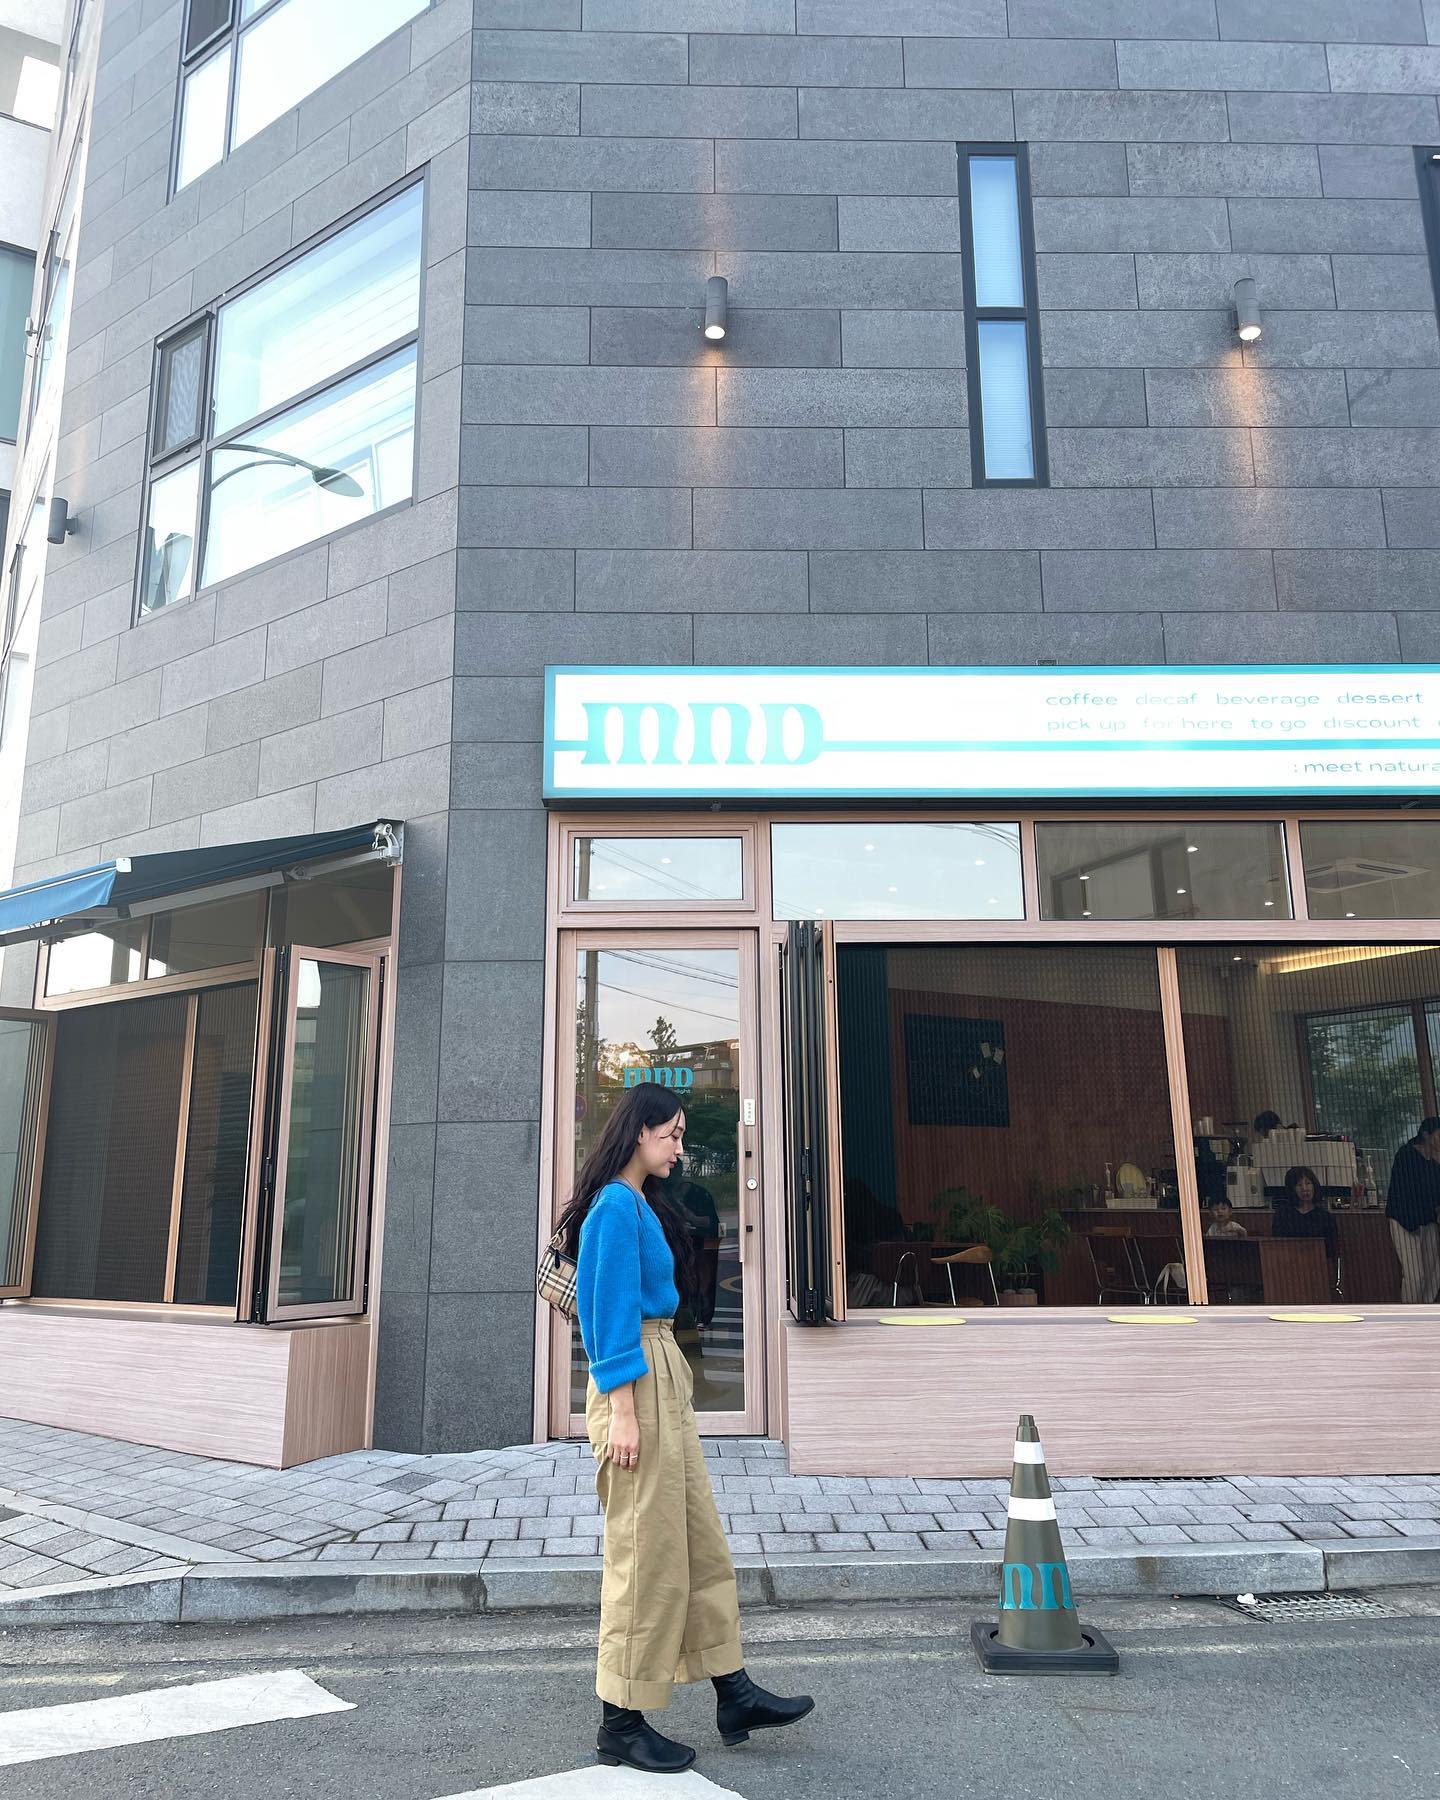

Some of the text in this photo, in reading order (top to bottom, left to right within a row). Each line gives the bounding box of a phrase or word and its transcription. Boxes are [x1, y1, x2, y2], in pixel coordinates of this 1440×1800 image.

[1046, 692, 1424, 708] coffee decaf beverage dessert
[1047, 717, 1091, 732] pick
[1099, 719, 1127, 732] up
[1181, 717, 1233, 730] here
[1250, 717, 1273, 730] to
[1280, 720, 1307, 732] go
[1323, 716, 1421, 729] discount
[1304, 761, 1362, 773] meet
